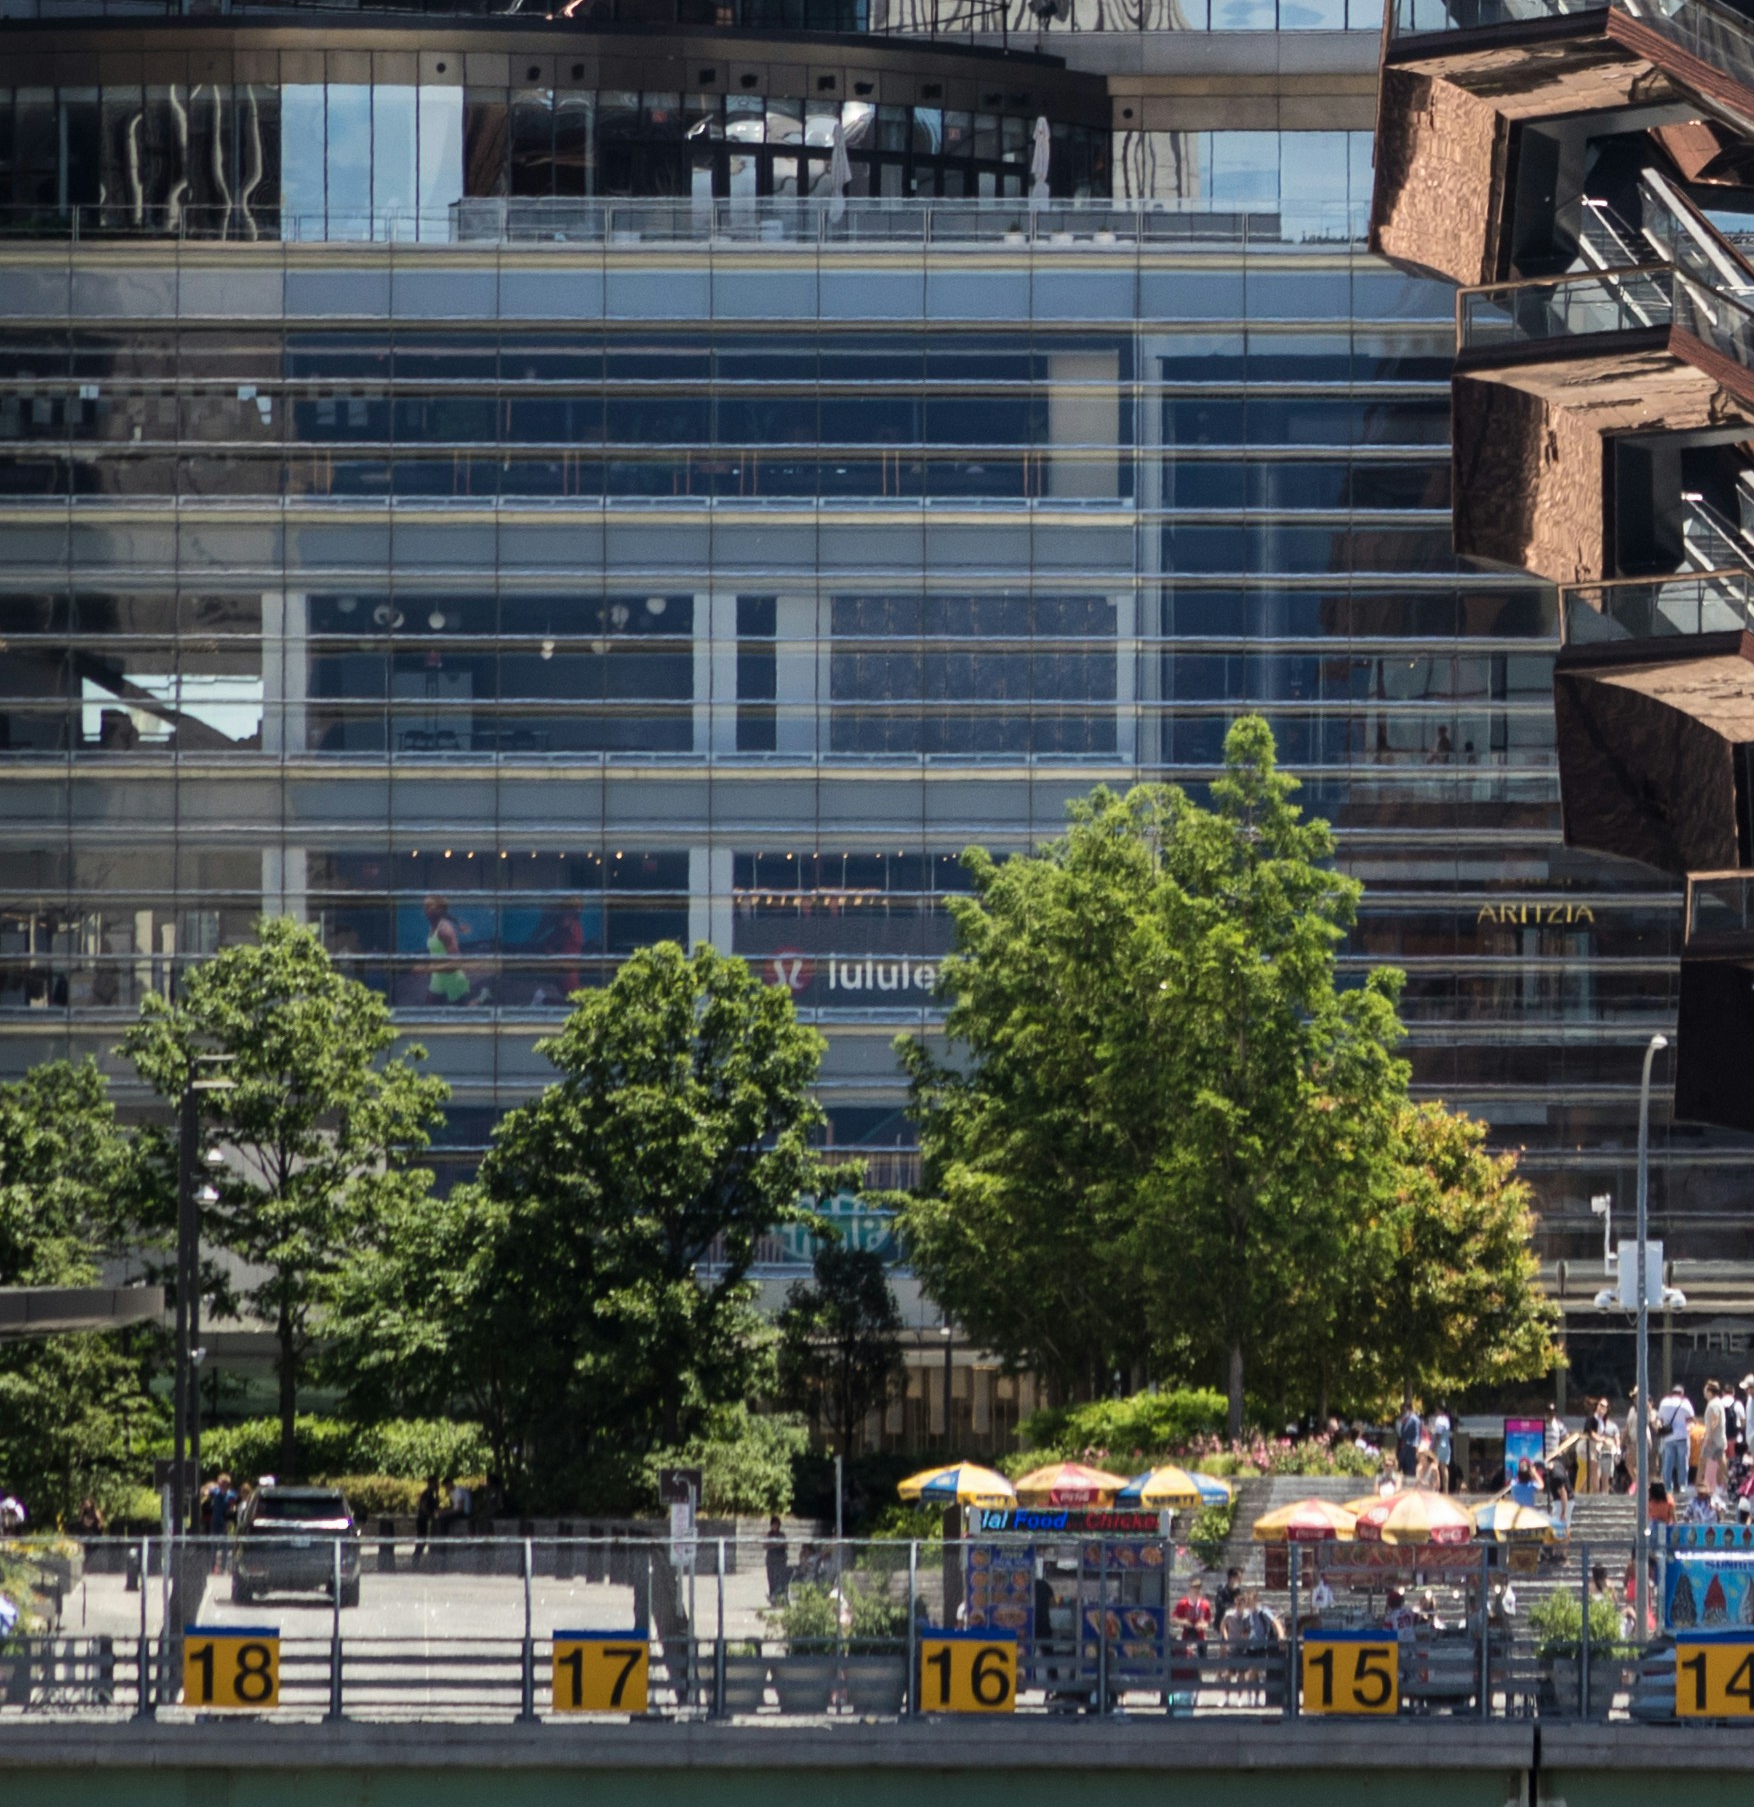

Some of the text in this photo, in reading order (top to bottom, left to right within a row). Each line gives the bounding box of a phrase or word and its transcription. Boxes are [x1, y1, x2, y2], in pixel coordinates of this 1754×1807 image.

[1477, 902, 1595, 924] ARITZIA
[1686, 1330, 1746, 1352] THE
[1014, 1508, 1068, 1530] Food
[190, 1642, 273, 1702] 18
[558, 1647, 643, 1706] 17
[927, 1647, 1011, 1706] 16
[1308, 1648, 1393, 1708] 15
